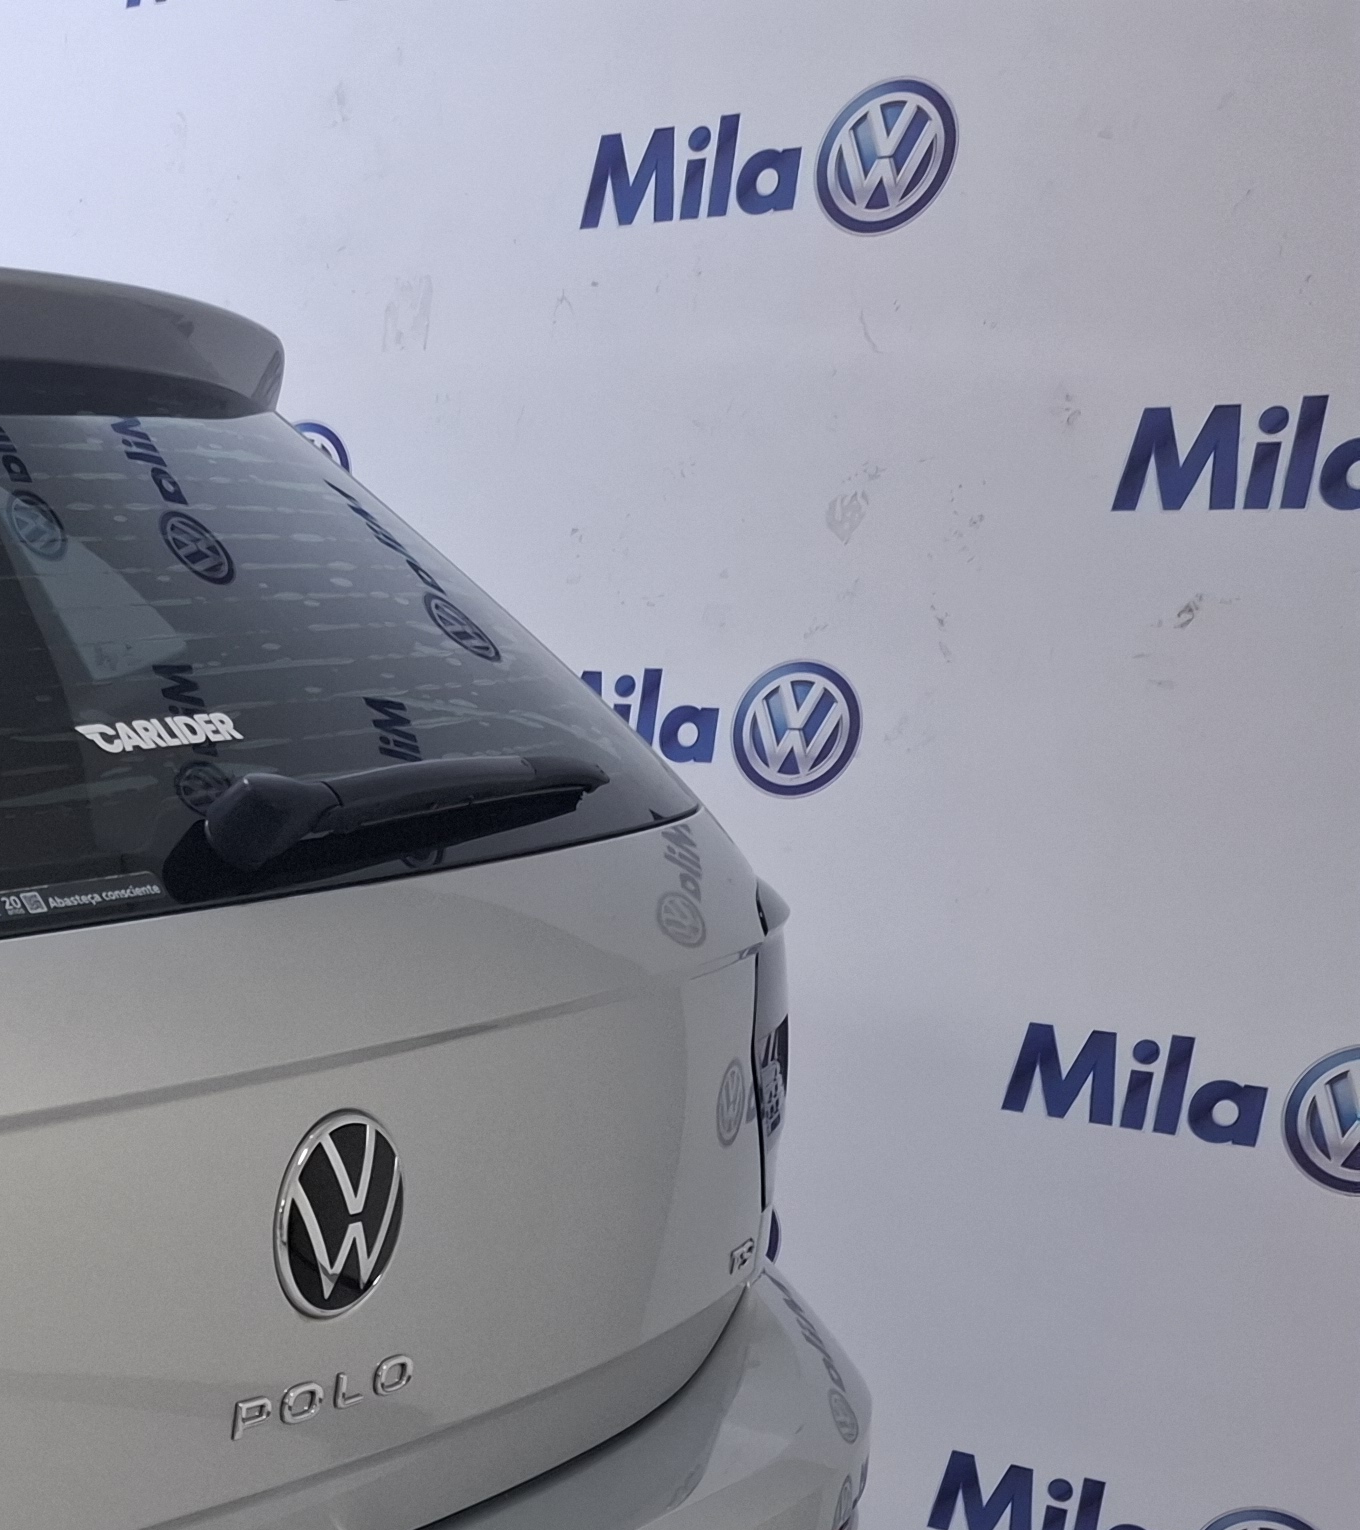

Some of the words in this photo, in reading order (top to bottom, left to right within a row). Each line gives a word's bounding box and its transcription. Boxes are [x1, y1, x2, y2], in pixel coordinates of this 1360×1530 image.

[579, 113, 803, 230] Mila
[75, 712, 244, 753] CARLIDER
[580, 668, 720, 763] ila
[0, 896, 22, 910] 20
[48, 894, 102, 909] Abasteça
[101, 884, 162, 901] consciente
[1001, 1022, 1268, 1147] Mila
[231, 1354, 414, 1441] POLO
